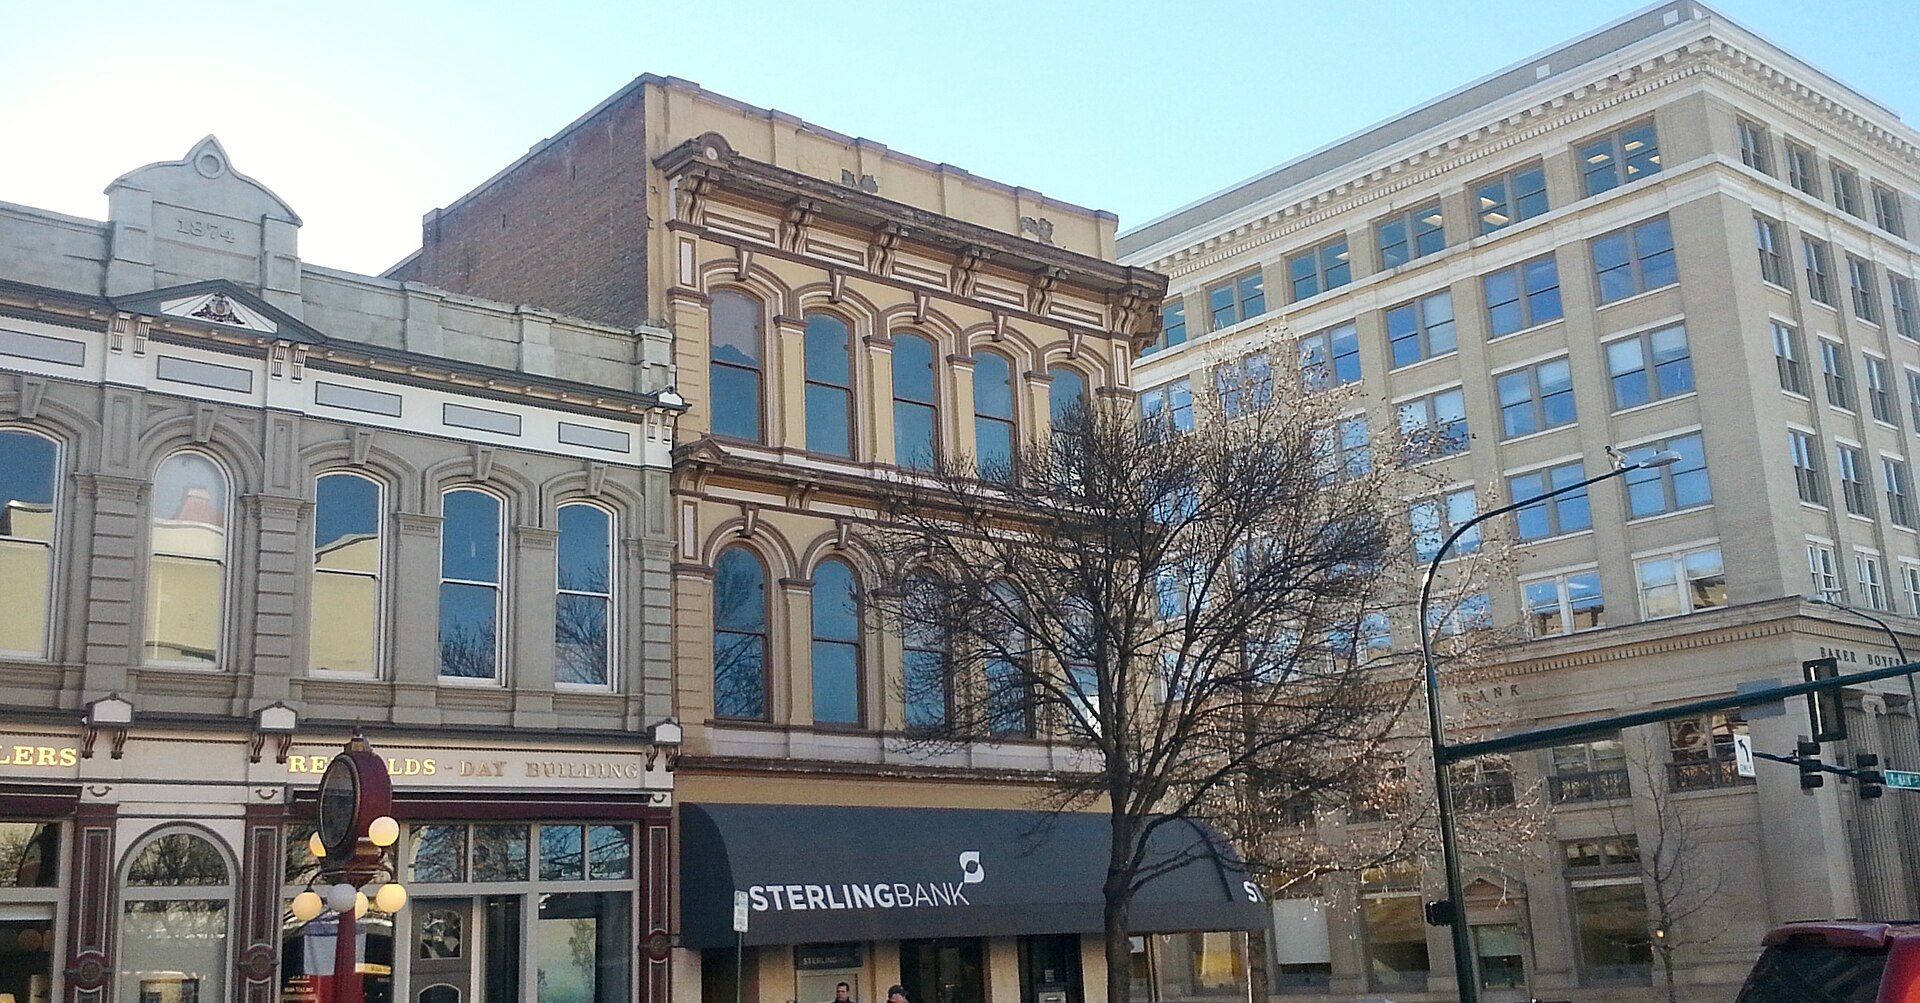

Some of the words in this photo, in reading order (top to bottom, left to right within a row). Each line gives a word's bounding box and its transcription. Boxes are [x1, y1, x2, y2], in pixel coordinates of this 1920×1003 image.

[176, 219, 236, 244] 1874
[1820, 646, 1857, 663] BAKER
[288, 755, 437, 775] RELDS
[460, 760, 507, 777] DAY
[526, 761, 638, 779] BUILDING
